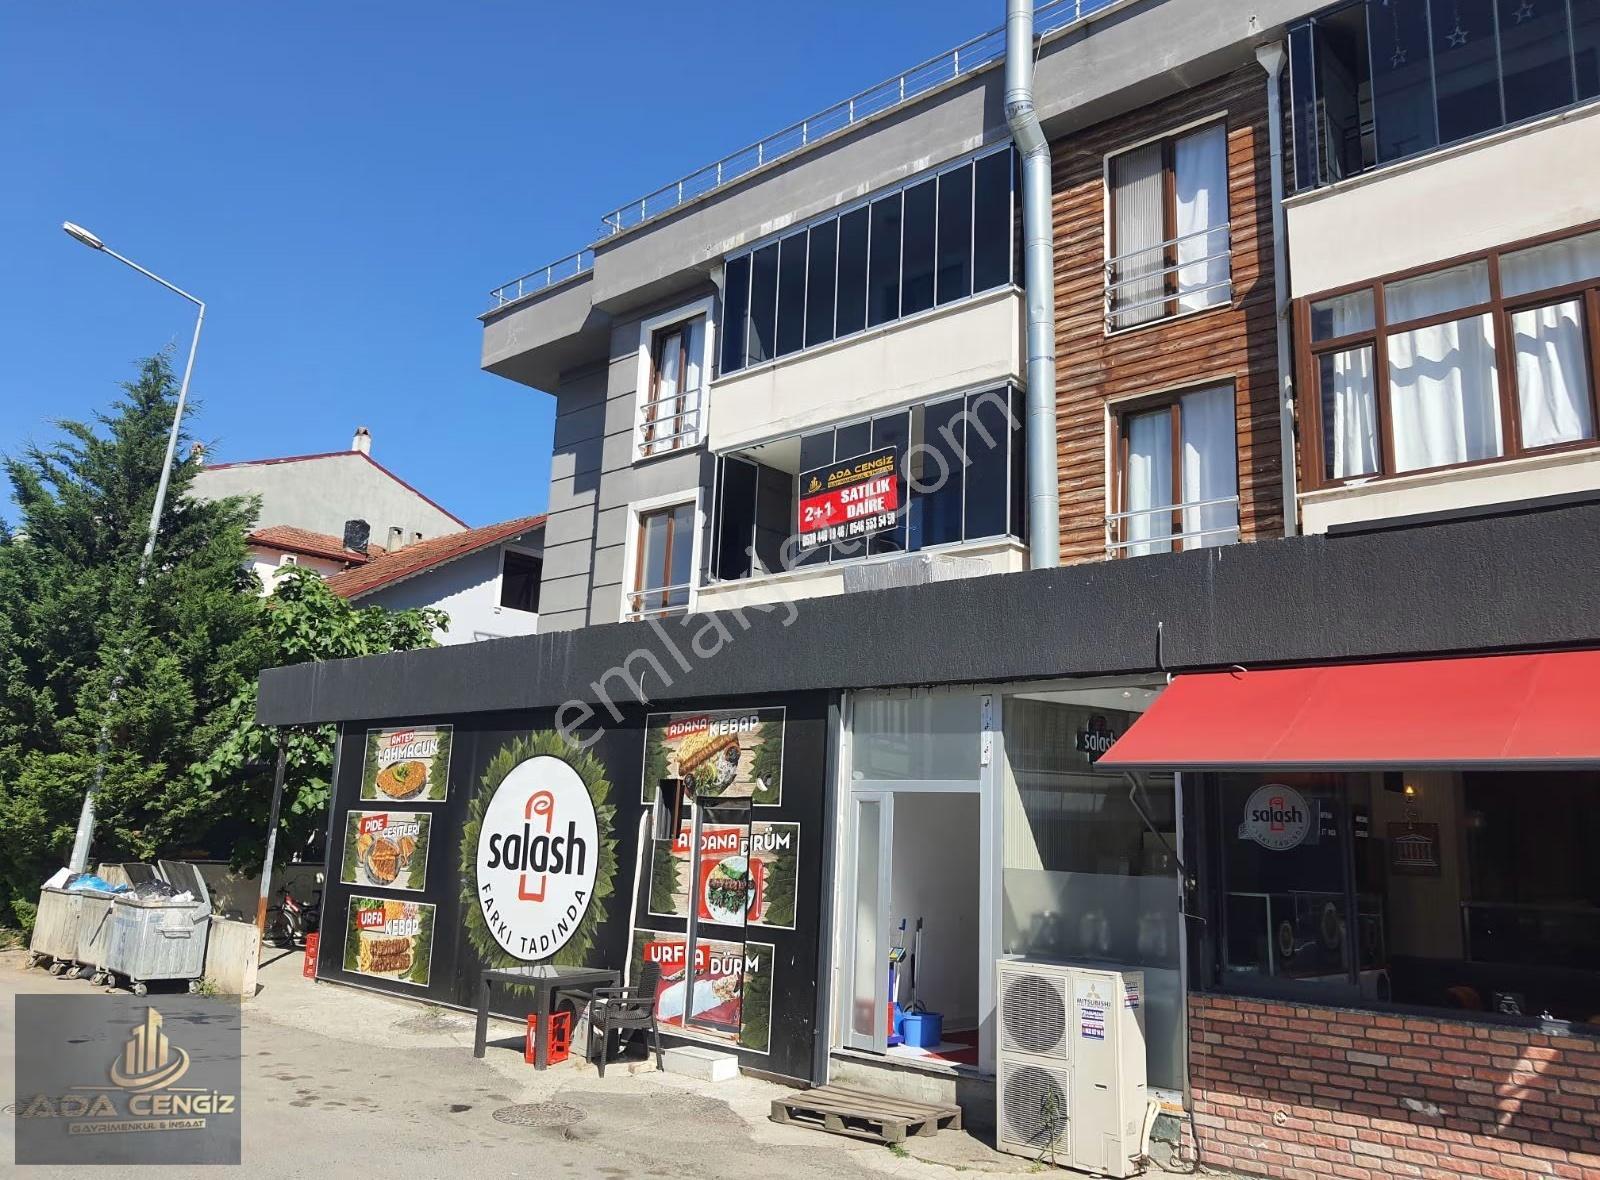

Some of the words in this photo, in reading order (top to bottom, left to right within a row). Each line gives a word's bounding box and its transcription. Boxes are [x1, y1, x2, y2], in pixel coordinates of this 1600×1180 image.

[828, 469, 852, 481] ADA
[841, 479, 890, 503] SATILIK
[805, 501, 832, 522] 2+1
[670, 718, 707, 736] ADANA
[709, 715, 759, 737] KEBAP
[391, 732, 414, 746] ANTEP
[376, 740, 439, 762] LAHMACUN
[1251, 805, 1303, 823] salash
[487, 821, 587, 876] salash
[361, 912, 383, 925] URFA
[385, 919, 419, 936] KEBAP
[481, 883, 512, 945] FARKI
[520, 890, 586, 954] TADINDA
[710, 951, 760, 975] DÜRM
